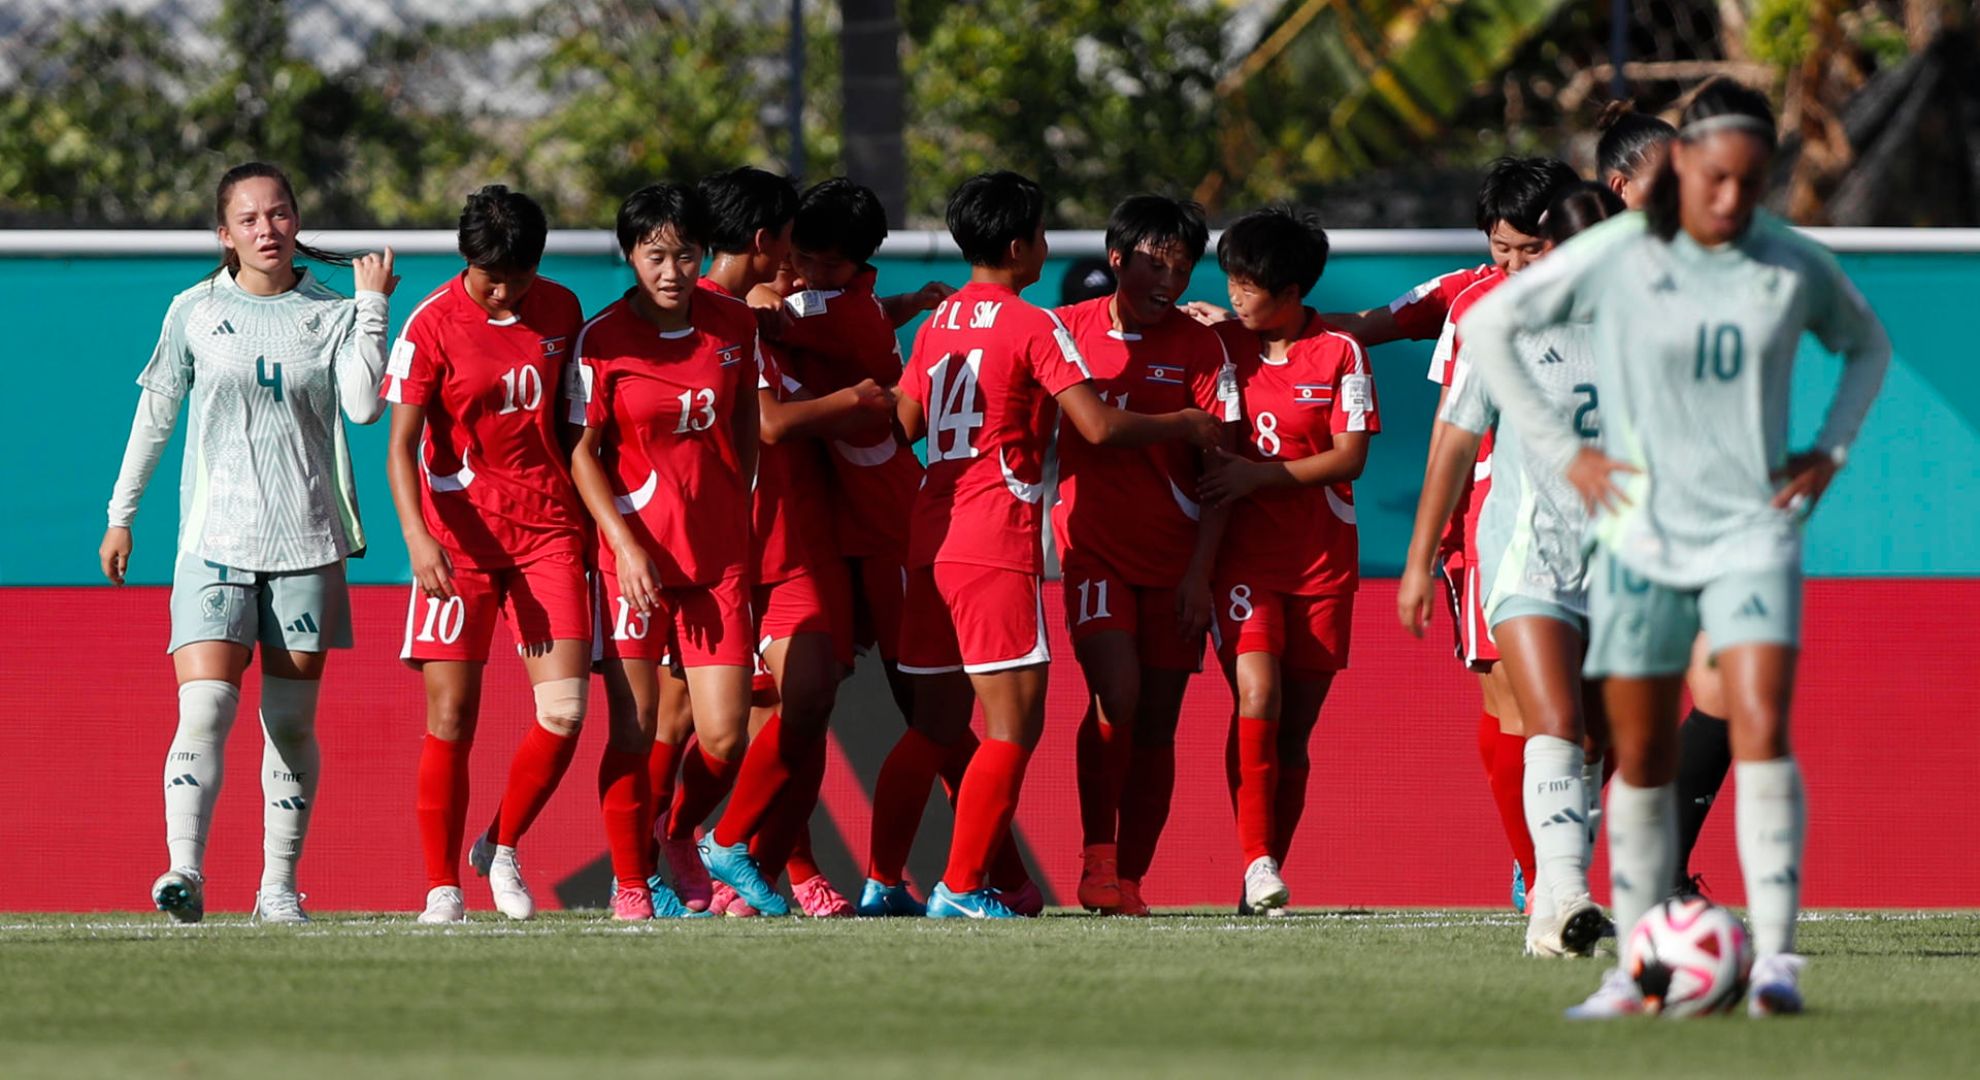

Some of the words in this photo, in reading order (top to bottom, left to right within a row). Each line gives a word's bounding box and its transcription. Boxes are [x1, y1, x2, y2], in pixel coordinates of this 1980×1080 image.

[1694, 322, 1743, 382] 10
[256, 355, 283, 402] 4
[499, 364, 542, 415] 10
[672, 388, 716, 434] 13
[927, 349, 984, 465] 14
[1573, 383, 1599, 439] 2
[1256, 411, 1281, 457] 8
[416, 596, 465, 645] 10
[1077, 579, 1112, 625] 11
[1229, 584, 1254, 621] 8
[170, 751, 201, 762] FMF
[273, 770, 306, 783] FMF
[1537, 780, 1572, 795] FMF
